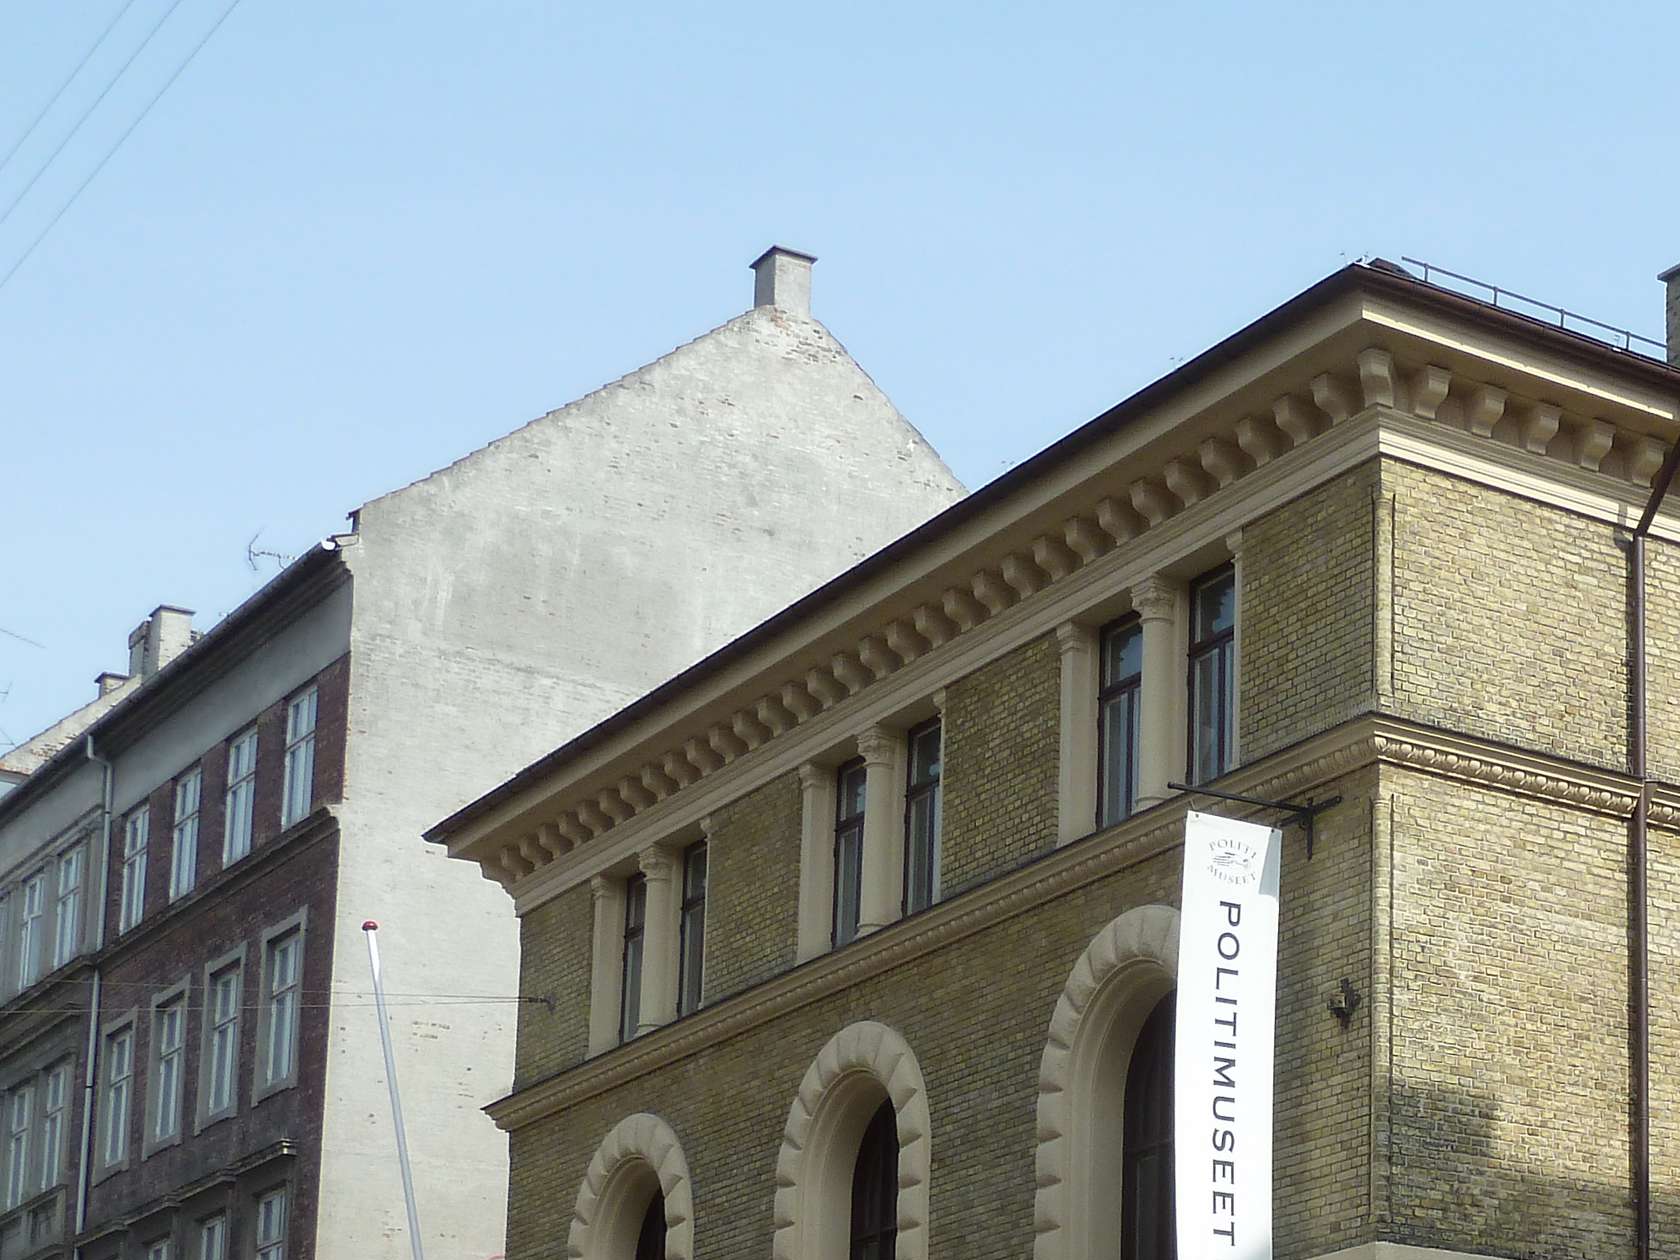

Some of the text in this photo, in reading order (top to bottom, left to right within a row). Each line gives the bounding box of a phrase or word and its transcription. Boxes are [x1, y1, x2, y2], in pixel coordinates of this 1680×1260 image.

[1208, 838, 1257, 860] POLITI
[1207, 864, 1257, 885] MUSEET
[1211, 900, 1242, 1248] POLITIMUSEET
